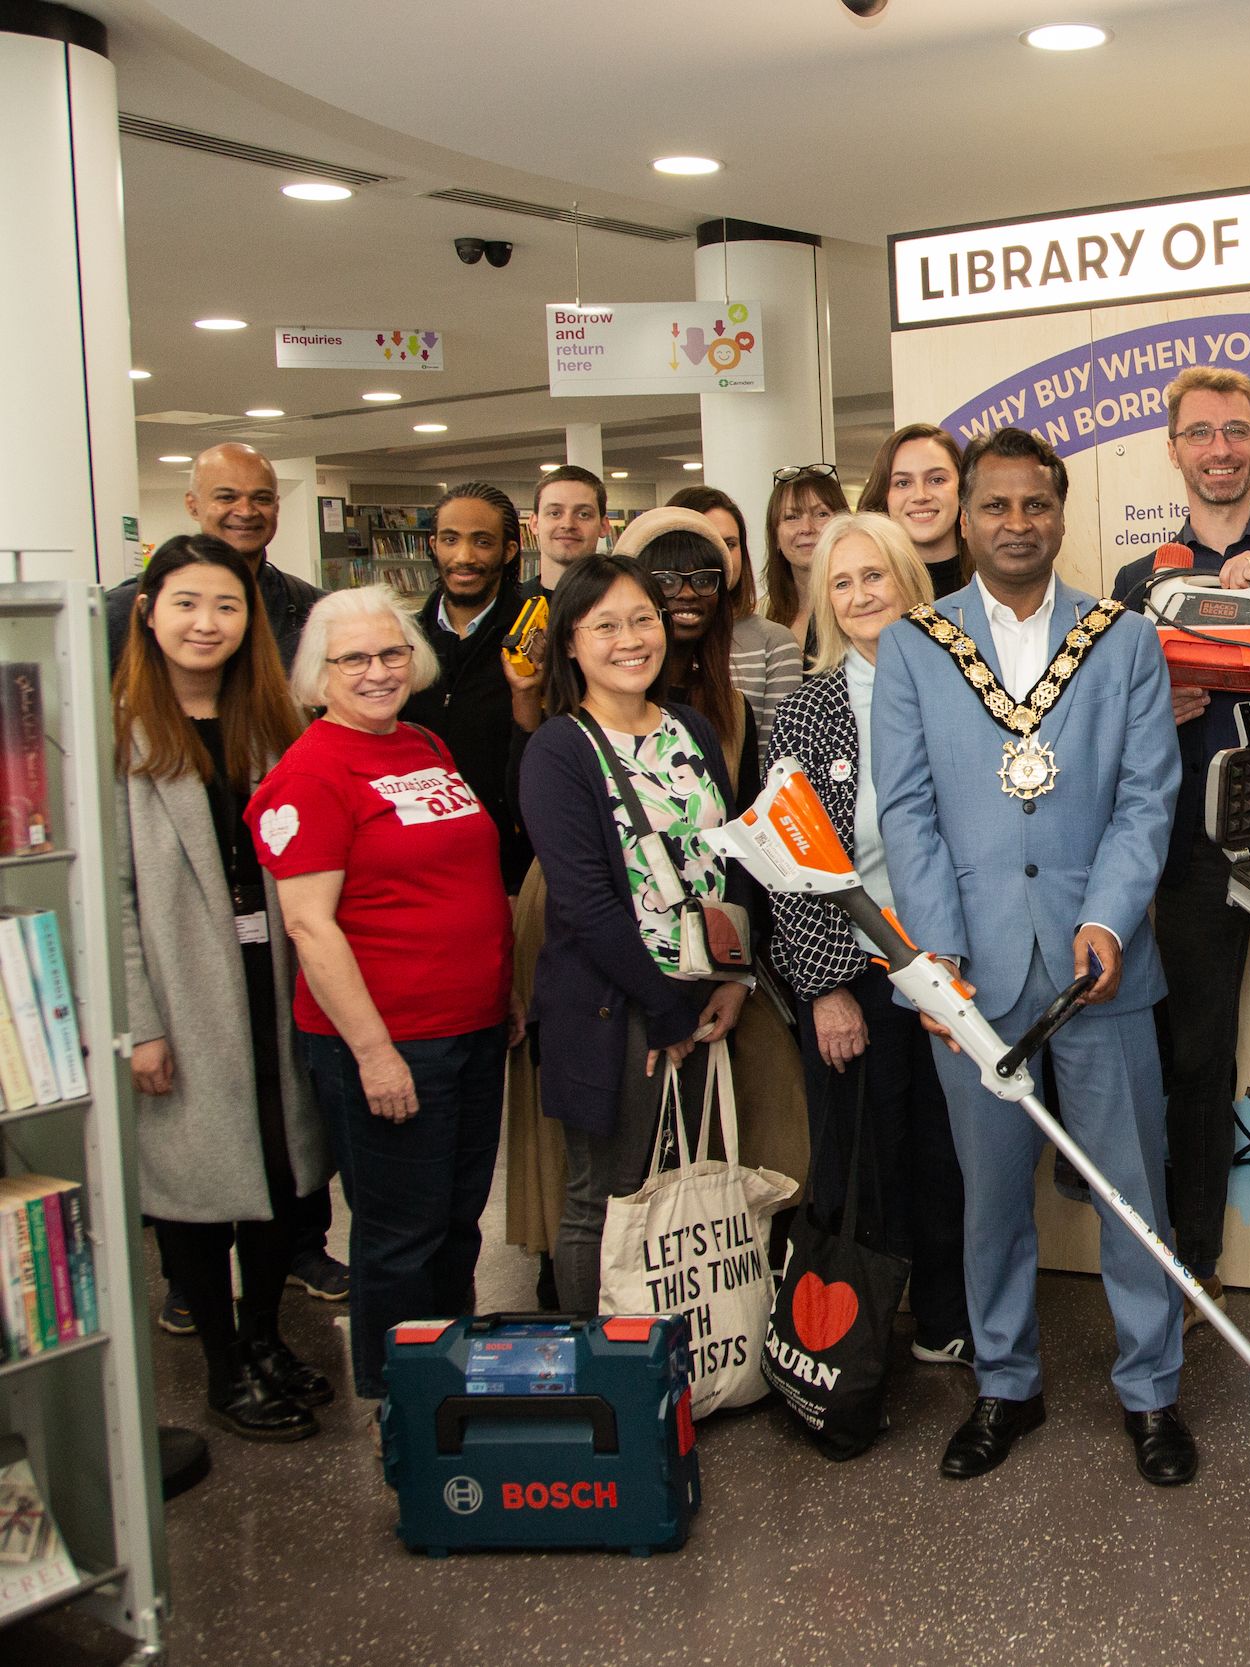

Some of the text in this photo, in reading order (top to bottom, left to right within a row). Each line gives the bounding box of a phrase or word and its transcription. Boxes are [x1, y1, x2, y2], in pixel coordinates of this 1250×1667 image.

[920, 229, 1145, 300] LIBRARY
[1162, 217, 1239, 272] OF
[555, 311, 613, 324] Borrow
[282, 333, 343, 346] Enquiries
[555, 327, 585, 340] and
[556, 344, 604, 356] return
[557, 359, 592, 372] here
[958, 388, 1027, 440] WHY
[1033, 361, 1091, 409] BUY
[1098, 337, 1197, 382] WHEN
[1073, 387, 1171, 436] BORR
[1125, 503, 1164, 521] Rent
[1169, 502, 1190, 518] ite
[1115, 529, 1177, 546] cleanin
[1202, 607, 1234, 616] DECKER
[779, 815, 811, 856] STIHL
[643, 1212, 754, 1273] LET'S FILL
[646, 1247, 762, 1313] THIS TOWN
[682, 1303, 712, 1343] TH
[485, 1343, 513, 1351] BOSCH
[689, 1334, 748, 1384] TISTS
[501, 1481, 618, 1509] BOSCH
